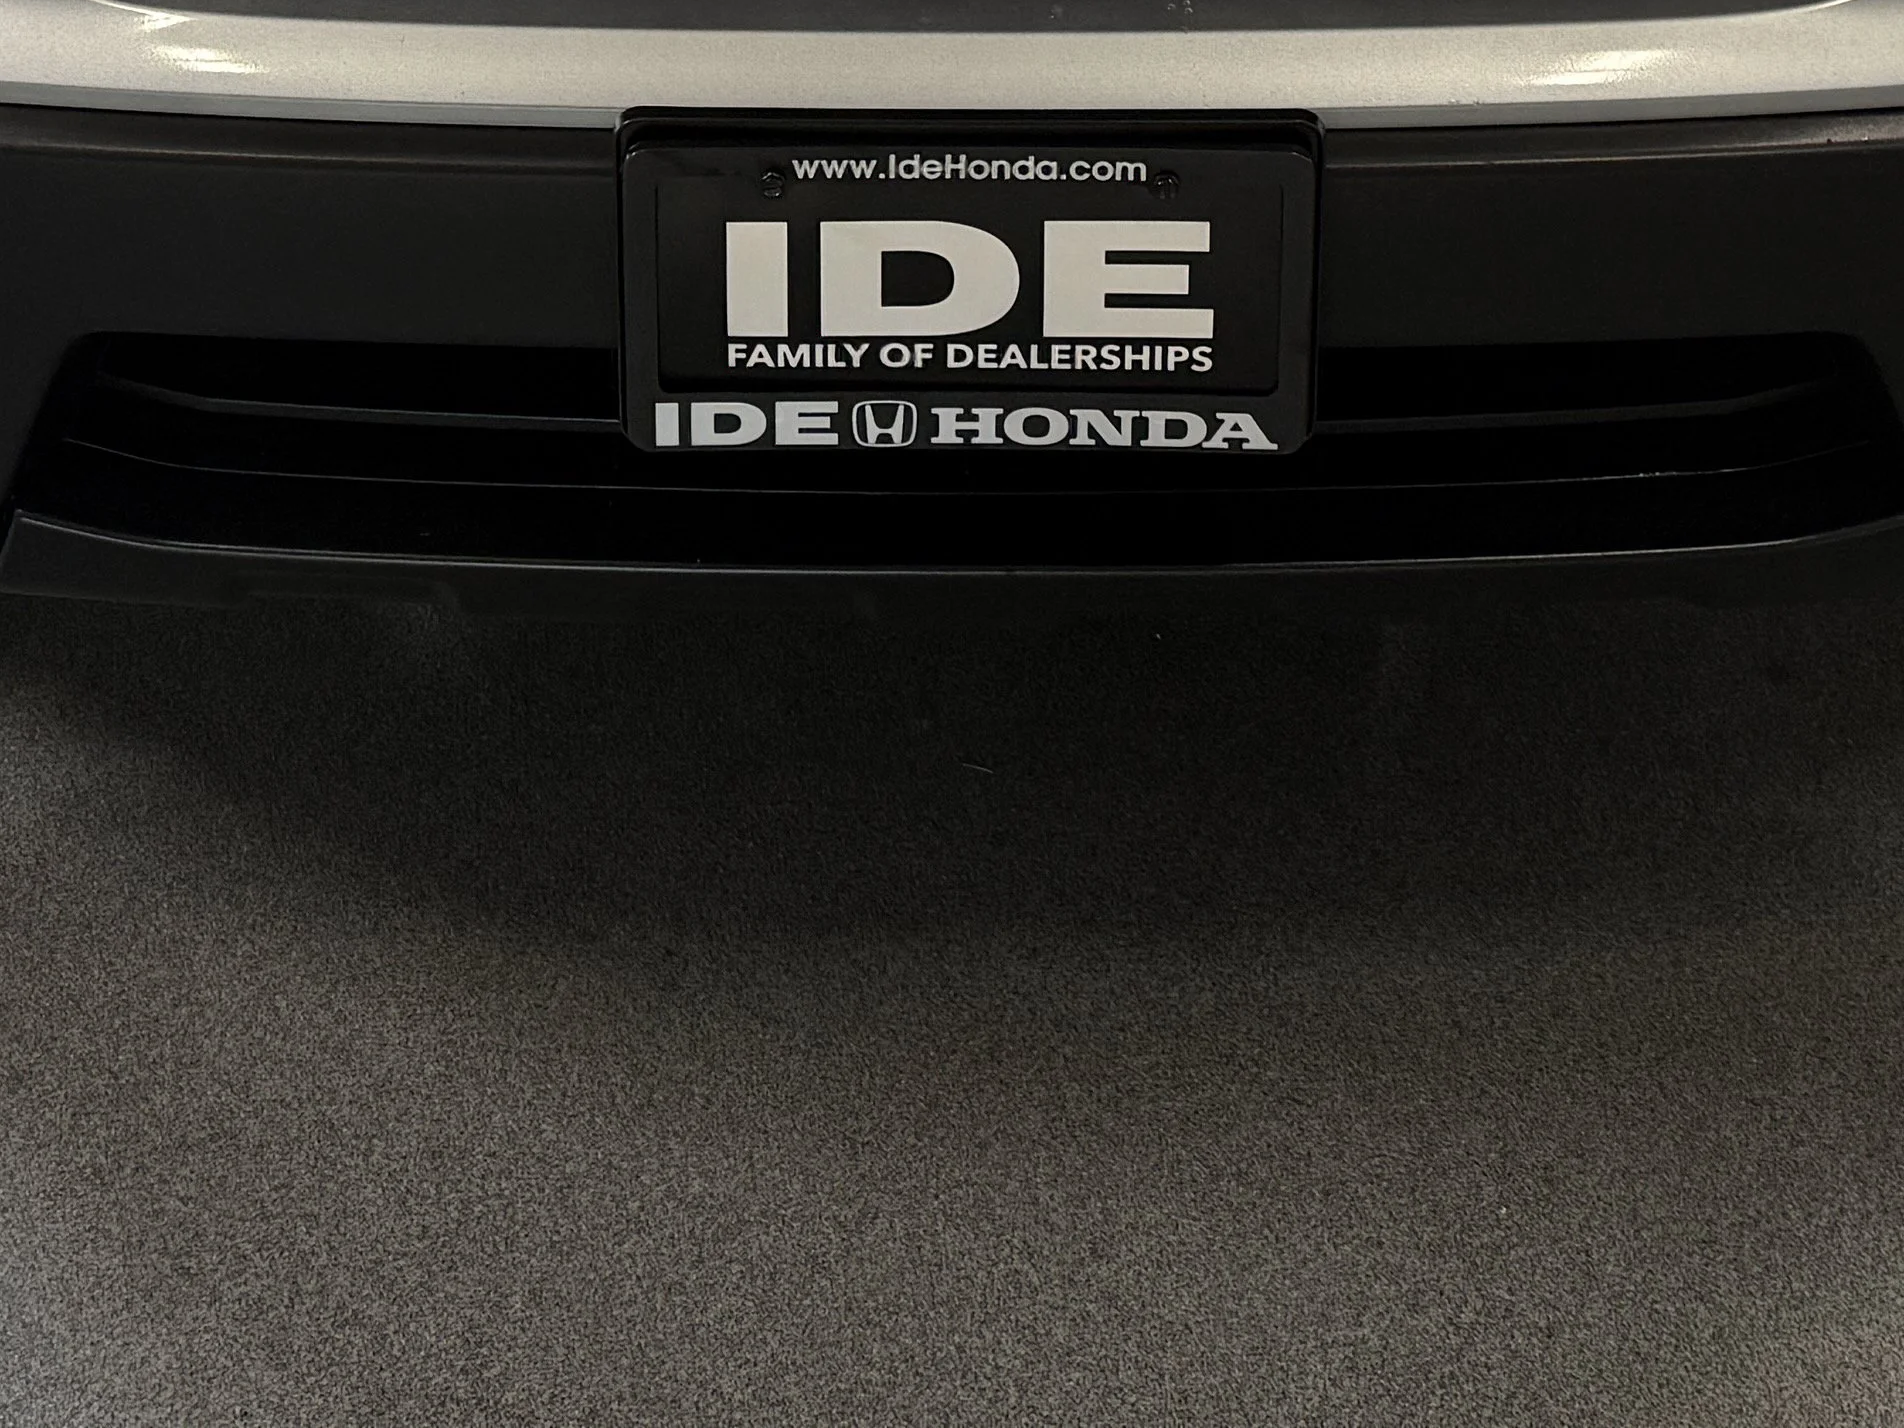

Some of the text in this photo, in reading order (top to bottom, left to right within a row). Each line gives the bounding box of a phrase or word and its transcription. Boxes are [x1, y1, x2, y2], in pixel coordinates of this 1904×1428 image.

[792, 154, 1147, 182] www.IdeHonda.com
[725, 220, 1215, 339] IDE
[727, 343, 1213, 372] FAMILY OF DEALERSHIPS
[654, 401, 839, 446] IDE
[930, 407, 1279, 450] HONDA
